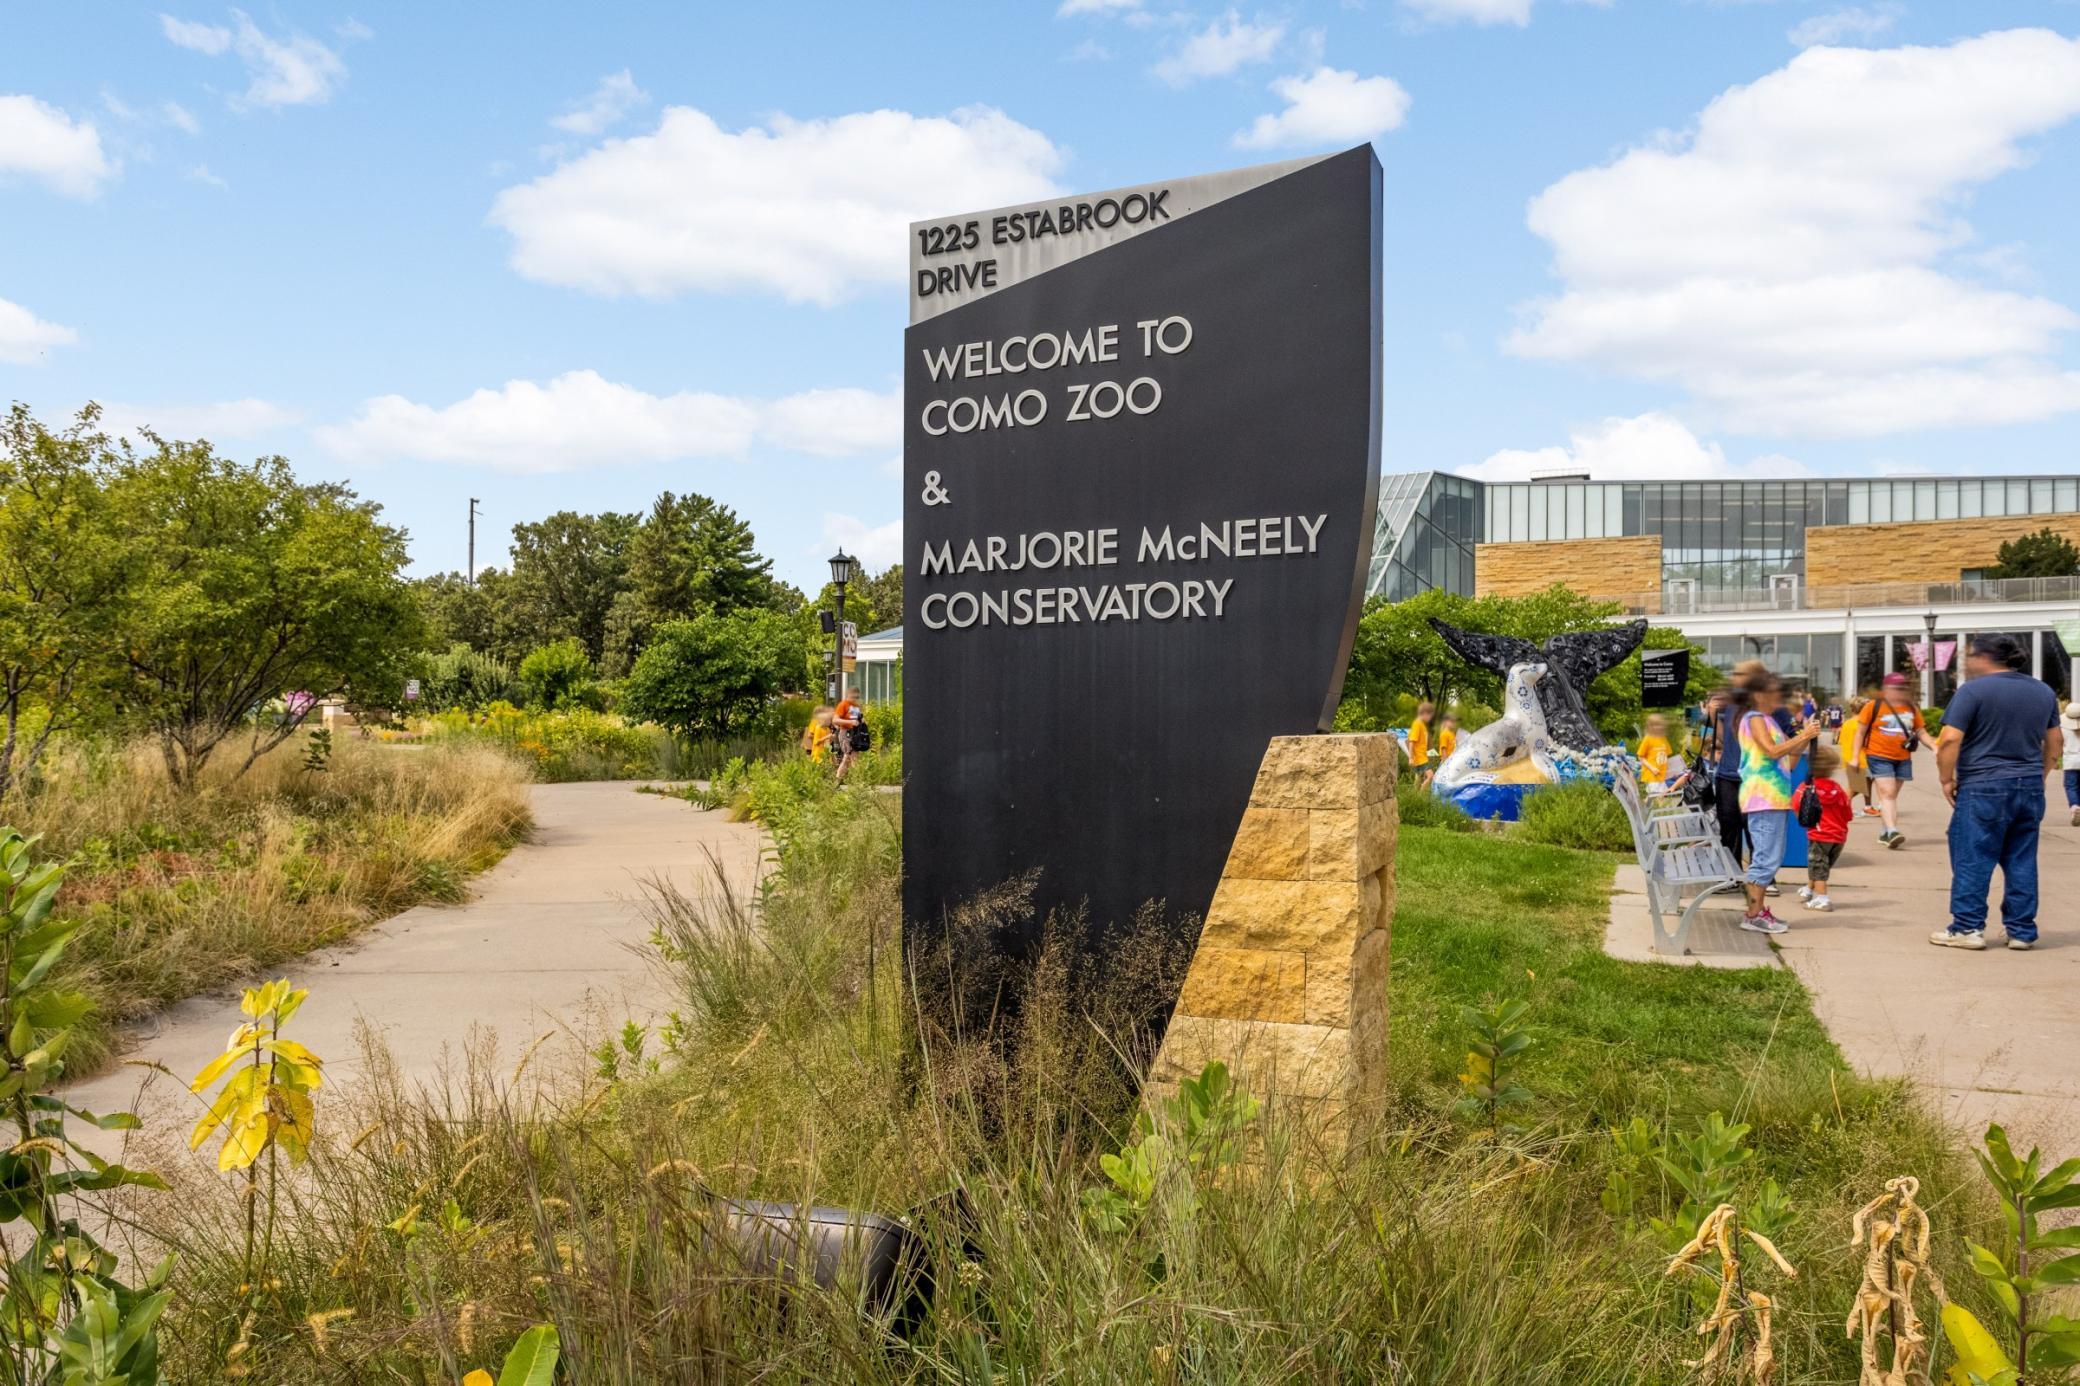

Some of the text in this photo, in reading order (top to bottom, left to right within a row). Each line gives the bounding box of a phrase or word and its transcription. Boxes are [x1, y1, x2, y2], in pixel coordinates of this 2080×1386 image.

[917, 189, 1170, 256] 1225 ESTABROOK
[917, 259, 997, 297] DRIVE
[922, 315, 1193, 382] WELCOME TO
[921, 376, 1162, 436] COMO ZOO
[921, 470, 951, 507] &
[920, 513, 1328, 576] MARJORIE McNEELY
[920, 578, 1235, 630] CONSERVATORY
